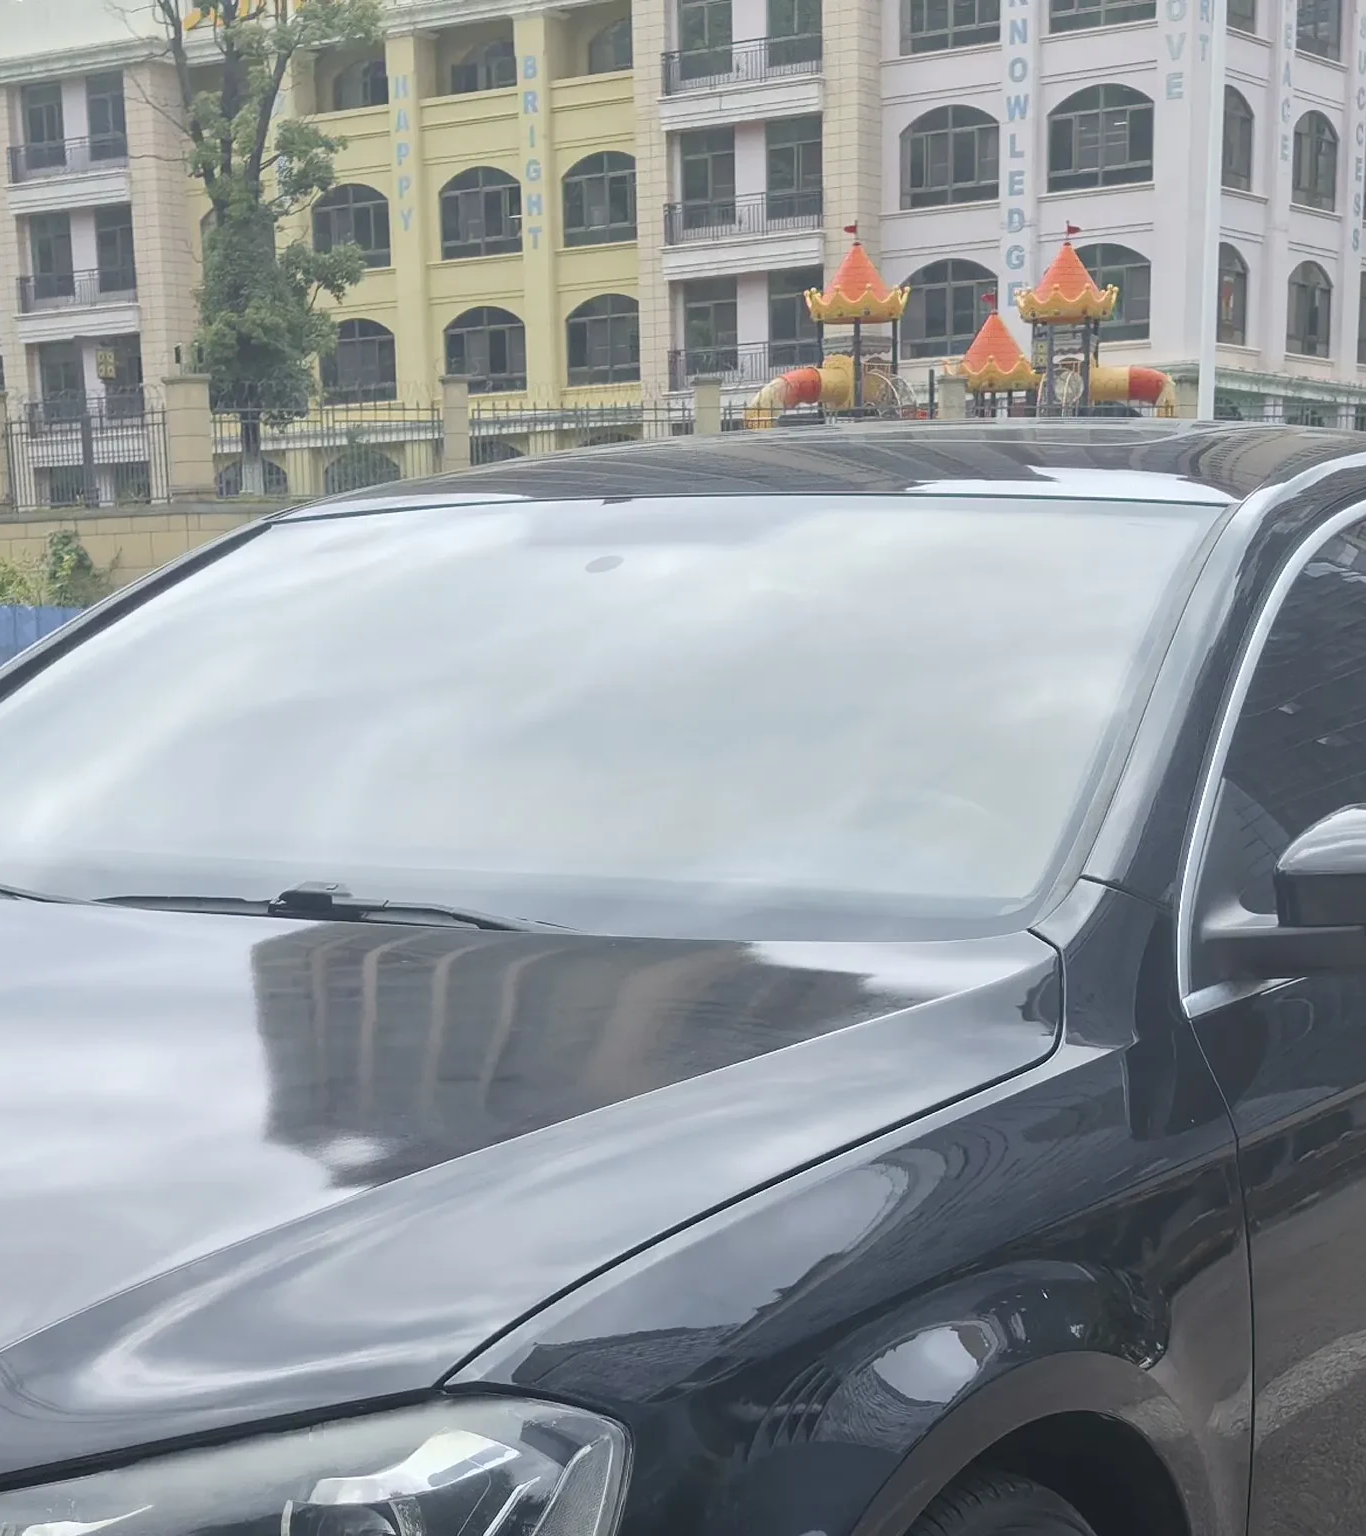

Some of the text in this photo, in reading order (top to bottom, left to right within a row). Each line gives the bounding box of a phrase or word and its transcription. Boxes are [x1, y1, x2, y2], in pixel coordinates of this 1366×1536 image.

[394, 74, 413, 232] HAPPY
[523, 55, 543, 250] BRIGHT
[1005, 0, 1030, 308] NOWLEDGE
